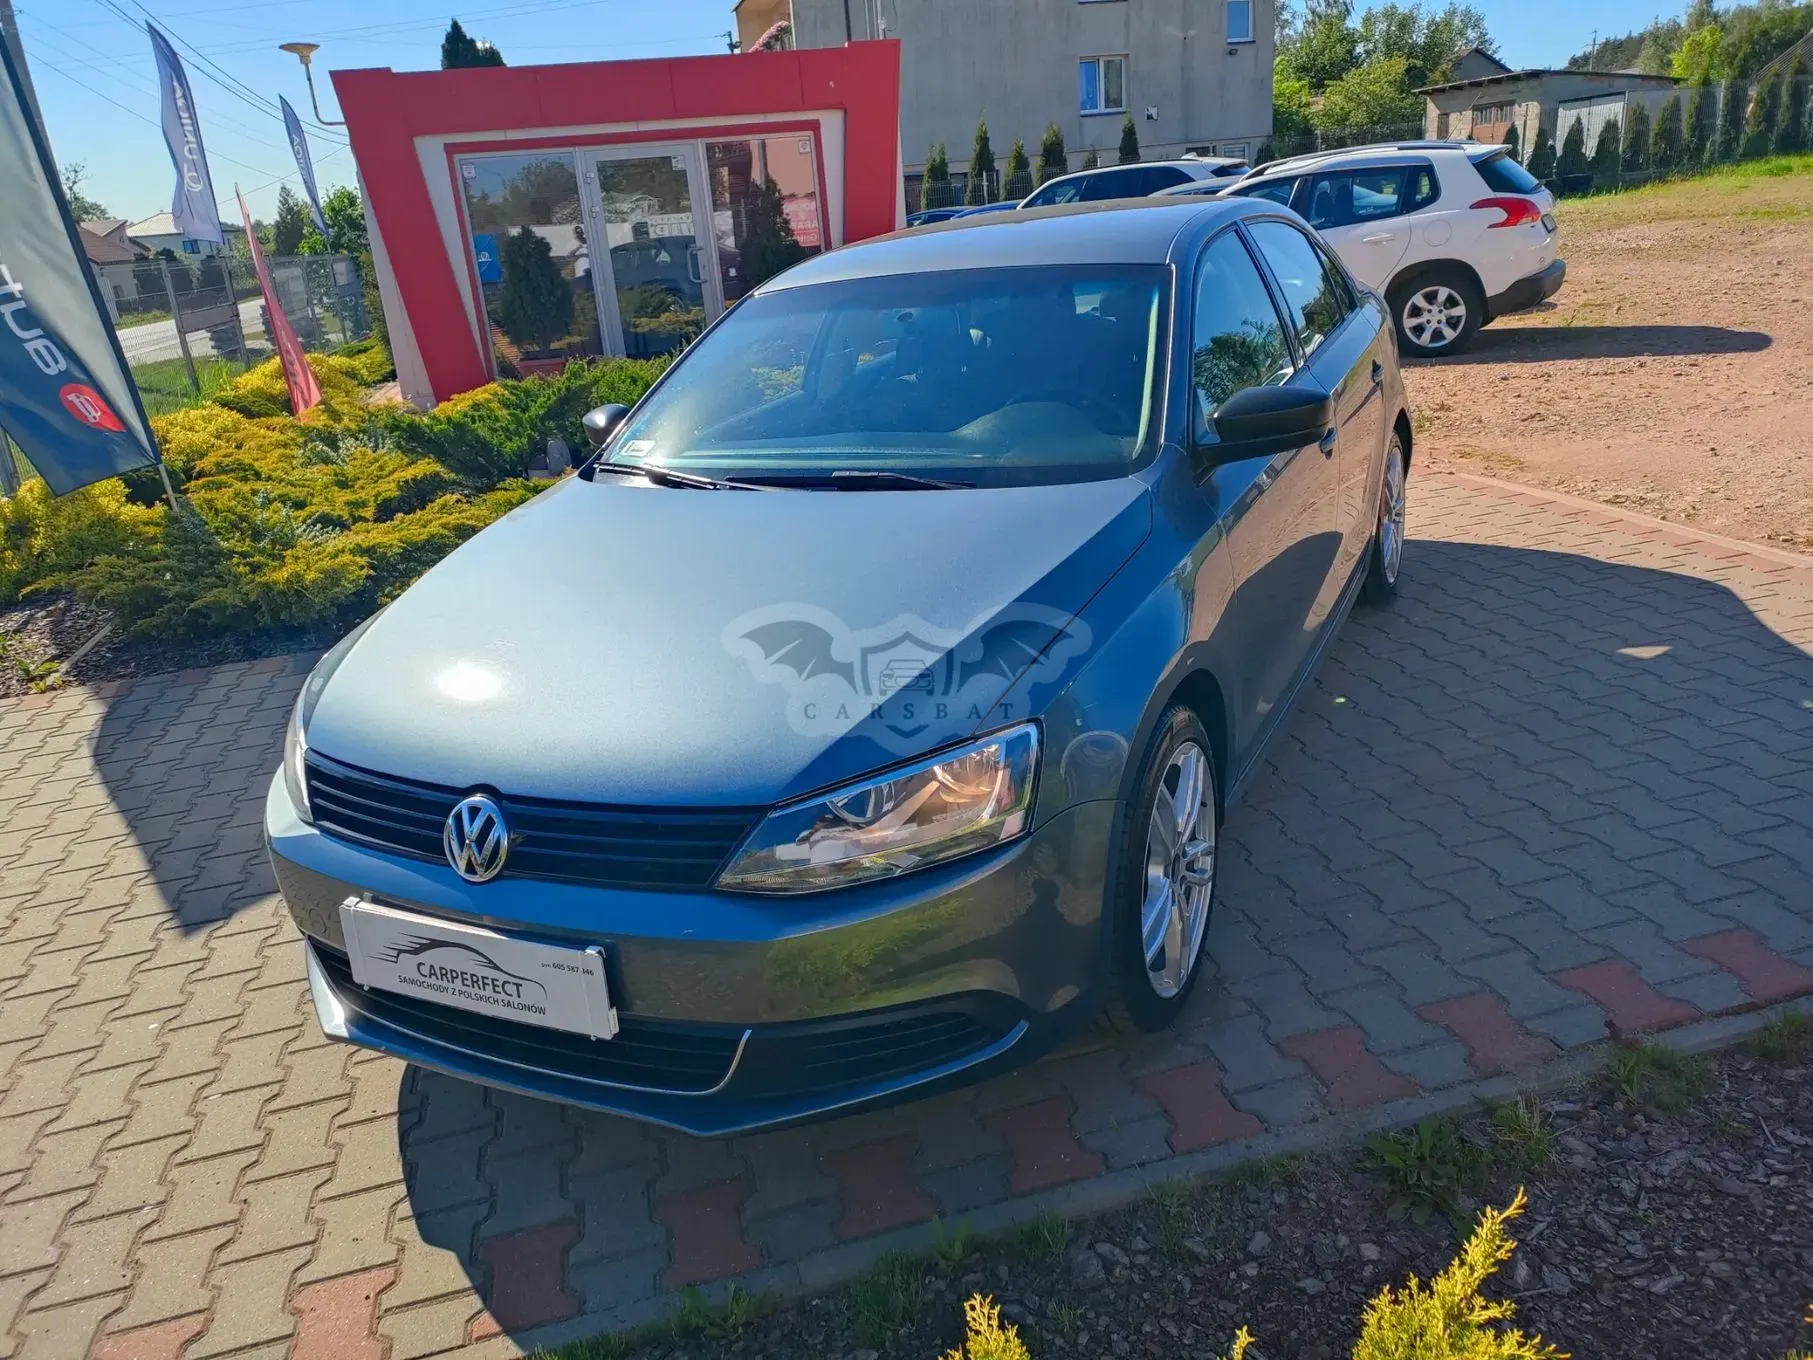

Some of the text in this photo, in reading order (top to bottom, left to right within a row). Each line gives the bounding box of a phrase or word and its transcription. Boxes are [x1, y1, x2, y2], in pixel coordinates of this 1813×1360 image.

[398, 975, 546, 1016] SAMOCHODY Z POLSKICH SALONÓW
[416, 961, 523, 998] CARPERFECT
